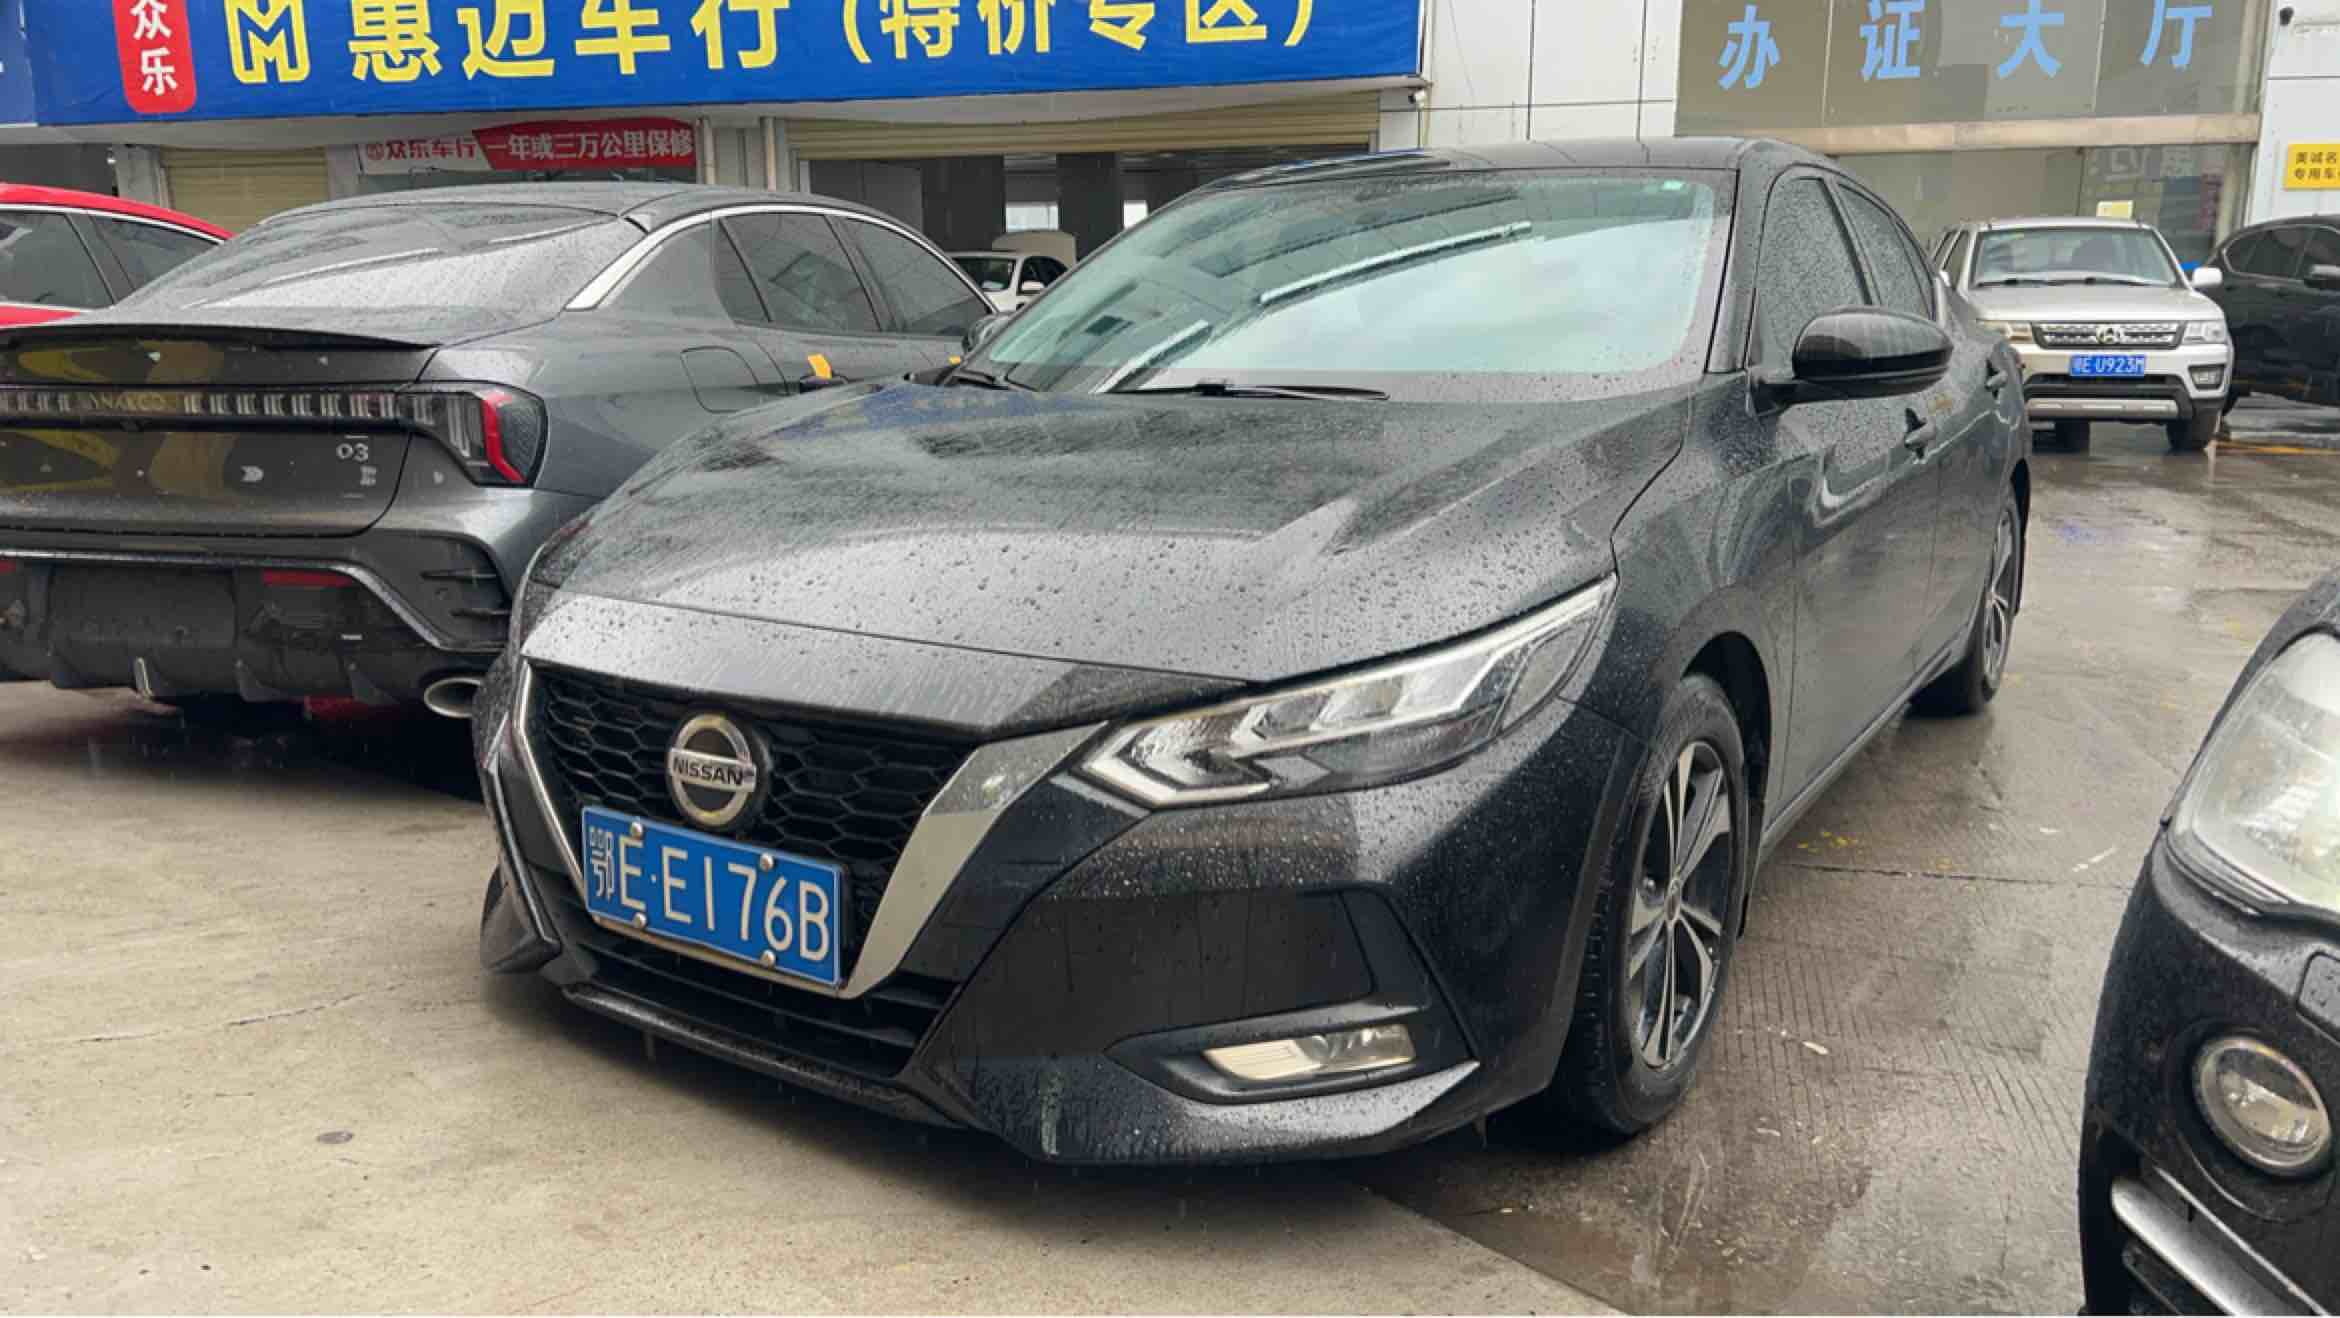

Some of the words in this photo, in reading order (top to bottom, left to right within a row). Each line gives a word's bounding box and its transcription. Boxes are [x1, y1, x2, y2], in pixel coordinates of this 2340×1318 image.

[130, 0, 178, 96] 众乐
[1717, 0, 2213, 90] 办证大厅
[387, 136, 479, 160] 众乐车行
[487, 128, 694, 161] 一年或三万公里保修
[2293, 167, 2340, 181] 专用车
[336, 442, 369, 462] 03
[672, 756, 744, 787] NISSAN
[588, 825, 830, 962] 鄂E·E176B
